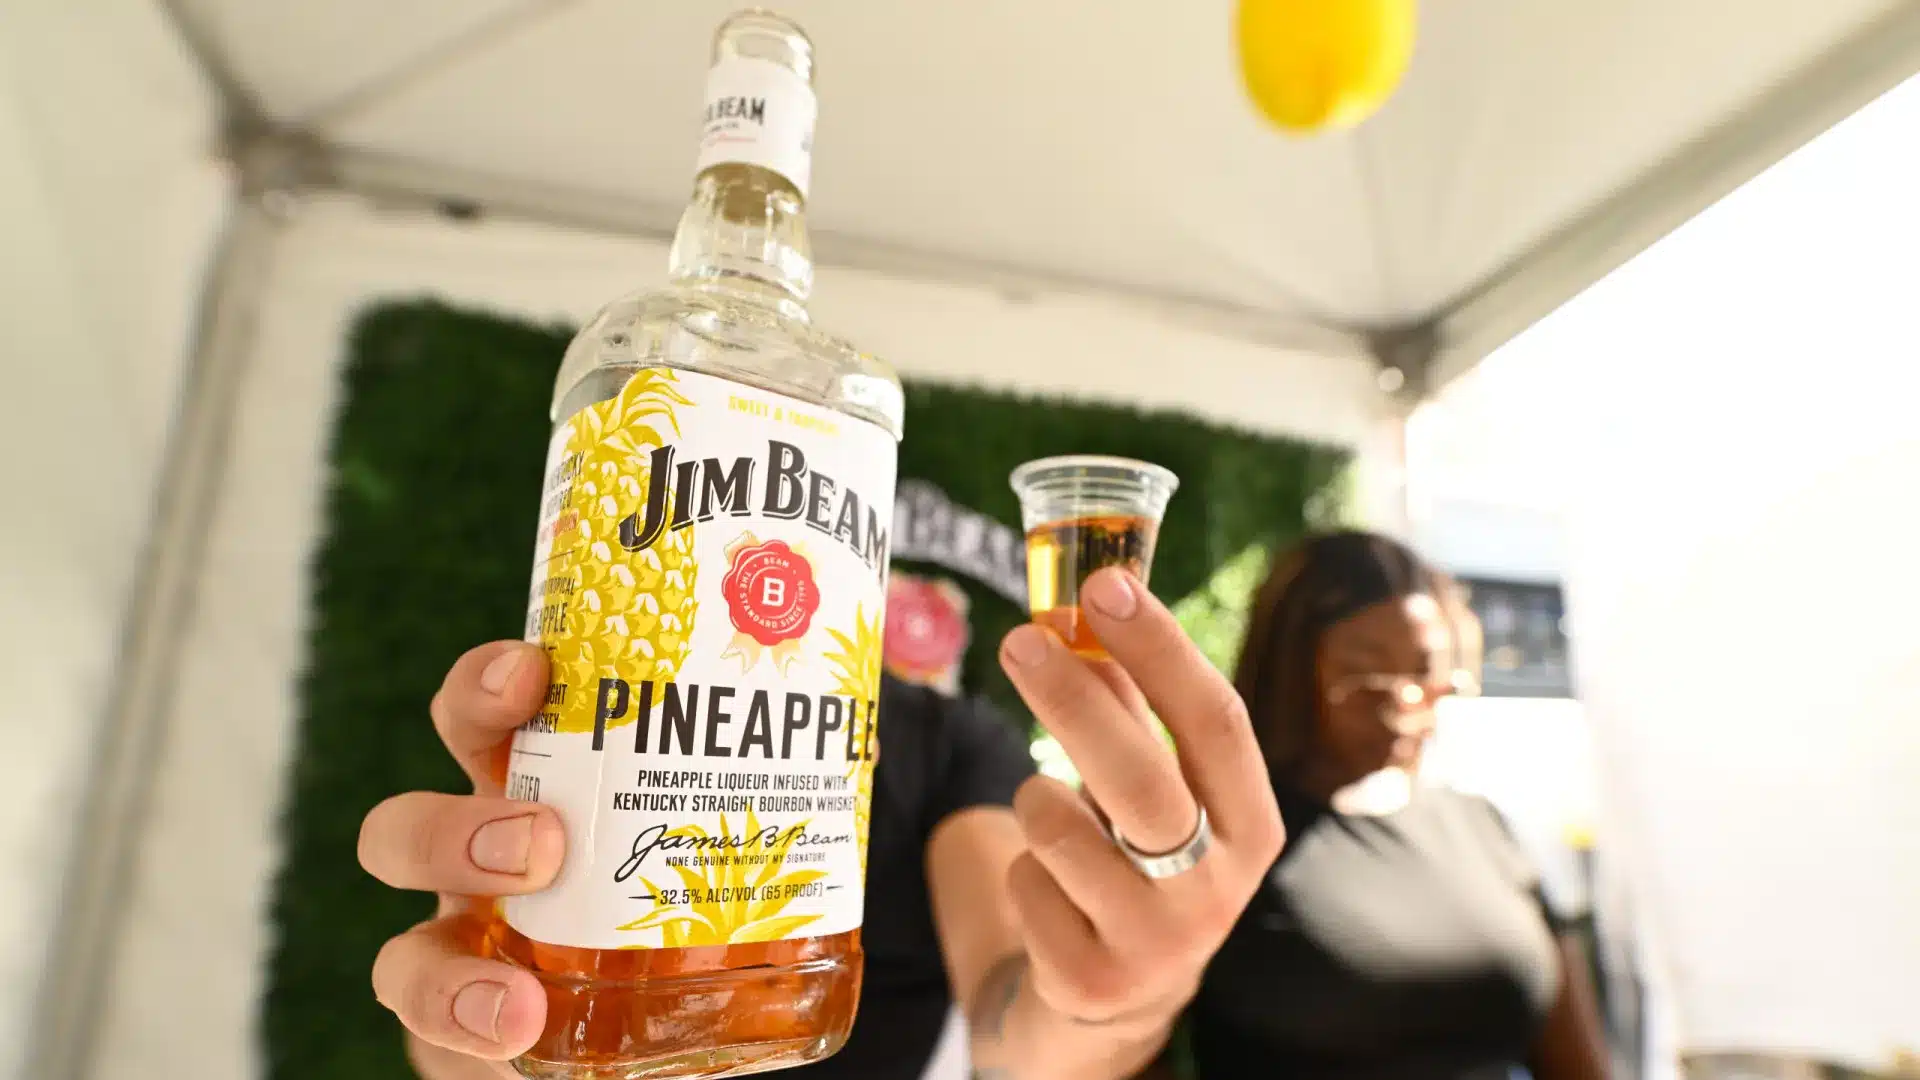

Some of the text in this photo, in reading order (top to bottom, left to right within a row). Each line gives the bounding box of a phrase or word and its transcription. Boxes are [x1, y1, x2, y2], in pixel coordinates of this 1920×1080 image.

[763, 557, 790, 569] BEAM
[739, 571, 752, 589] THE
[761, 576, 785, 607] B
[529, 602, 568, 637] EAPPLE
[739, 592, 778, 629] STANDARD
[780, 604, 803, 627] SINCE
[592, 677, 876, 762] PINEAPPLE
[637, 769, 848, 792] PINEAPPLE LIQUEUR INFUSED WITH
[613, 791, 687, 813] KENTUCKY
[692, 795, 756, 813] STRAIGHT
[759, 797, 813, 813] BOURBON
[615, 823, 749, 883] James
[666, 850, 827, 868] NONE GENUINE WITHOUT MY SIGNATURE
[660, 888, 703, 905] 32.5%
[706, 885, 757, 904] ALC/VOL
